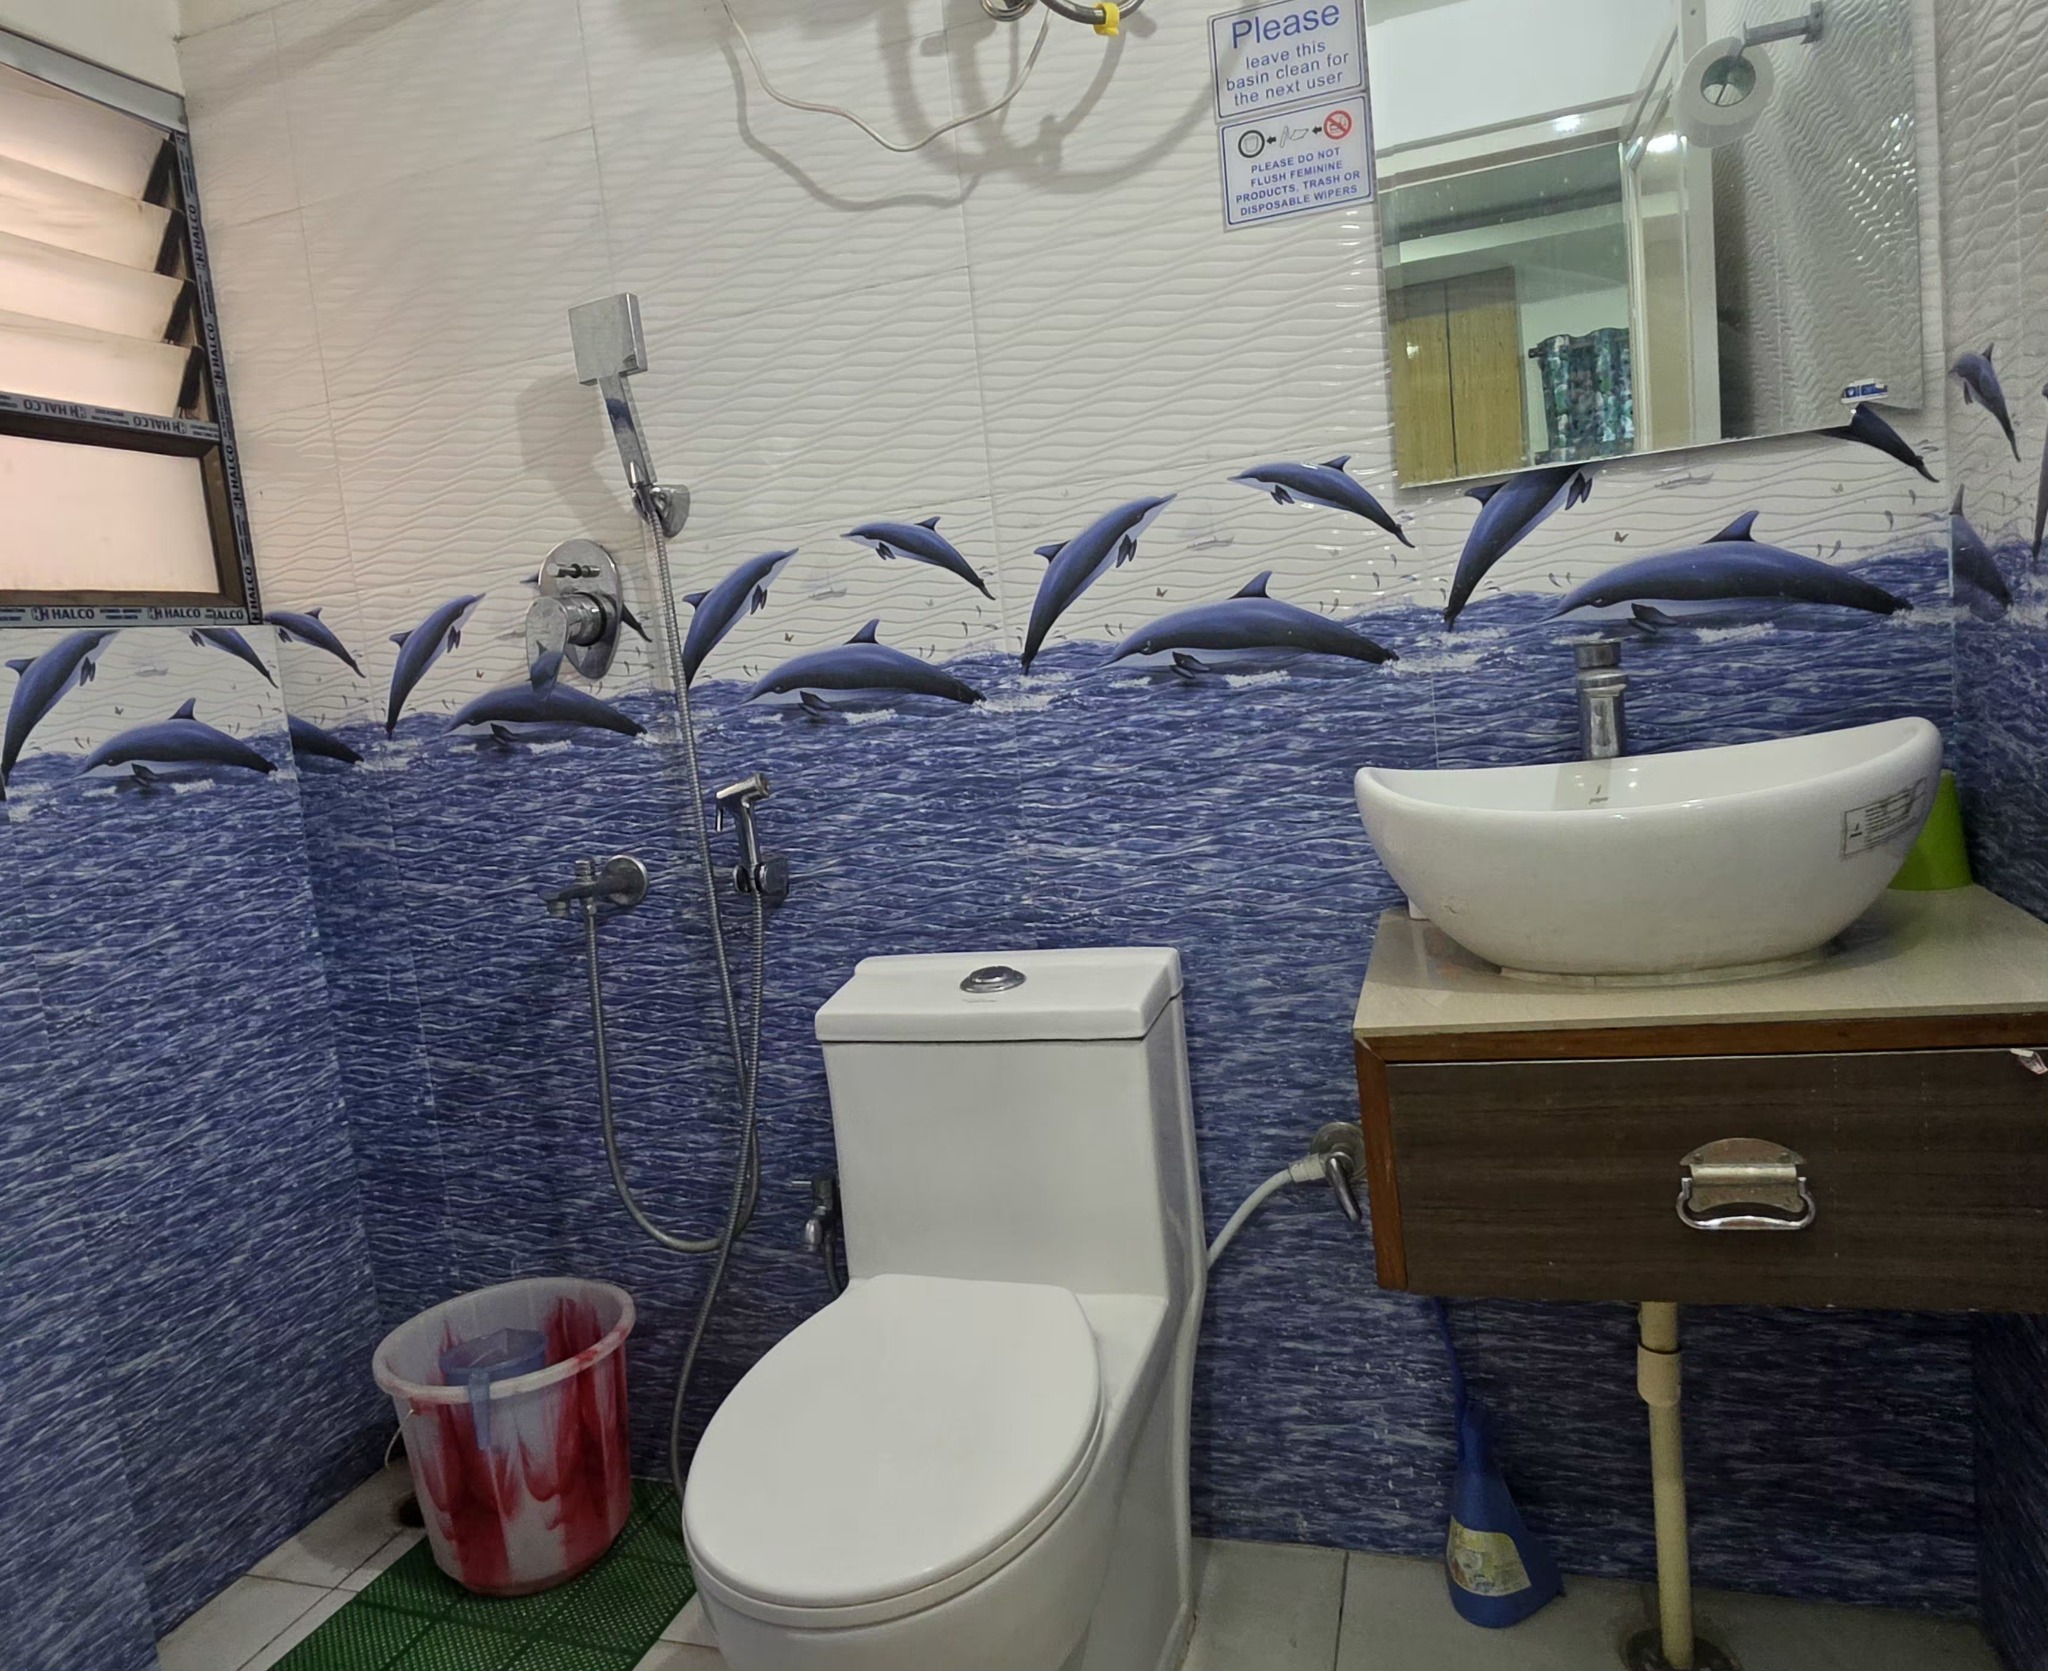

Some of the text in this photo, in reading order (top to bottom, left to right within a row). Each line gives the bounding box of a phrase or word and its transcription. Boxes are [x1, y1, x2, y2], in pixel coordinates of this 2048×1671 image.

[1231, 4, 1339, 49] Please
[1246, 41, 1326, 70] leave this
[1226, 52, 1349, 91] basin clean for
[1234, 71, 1343, 106] the next user
[1251, 147, 1341, 174] PLEASE DO NOT
[1251, 160, 1343, 187] FLUSH FEMININE
[1303, 174, 1340, 190] TRASH
[1344, 170, 1360, 181] OR
[1240, 184, 1358, 216] DISPOSABLE WIPERS
[51, 607, 95, 620] HALCO
[164, 607, 201, 619] HALCO
